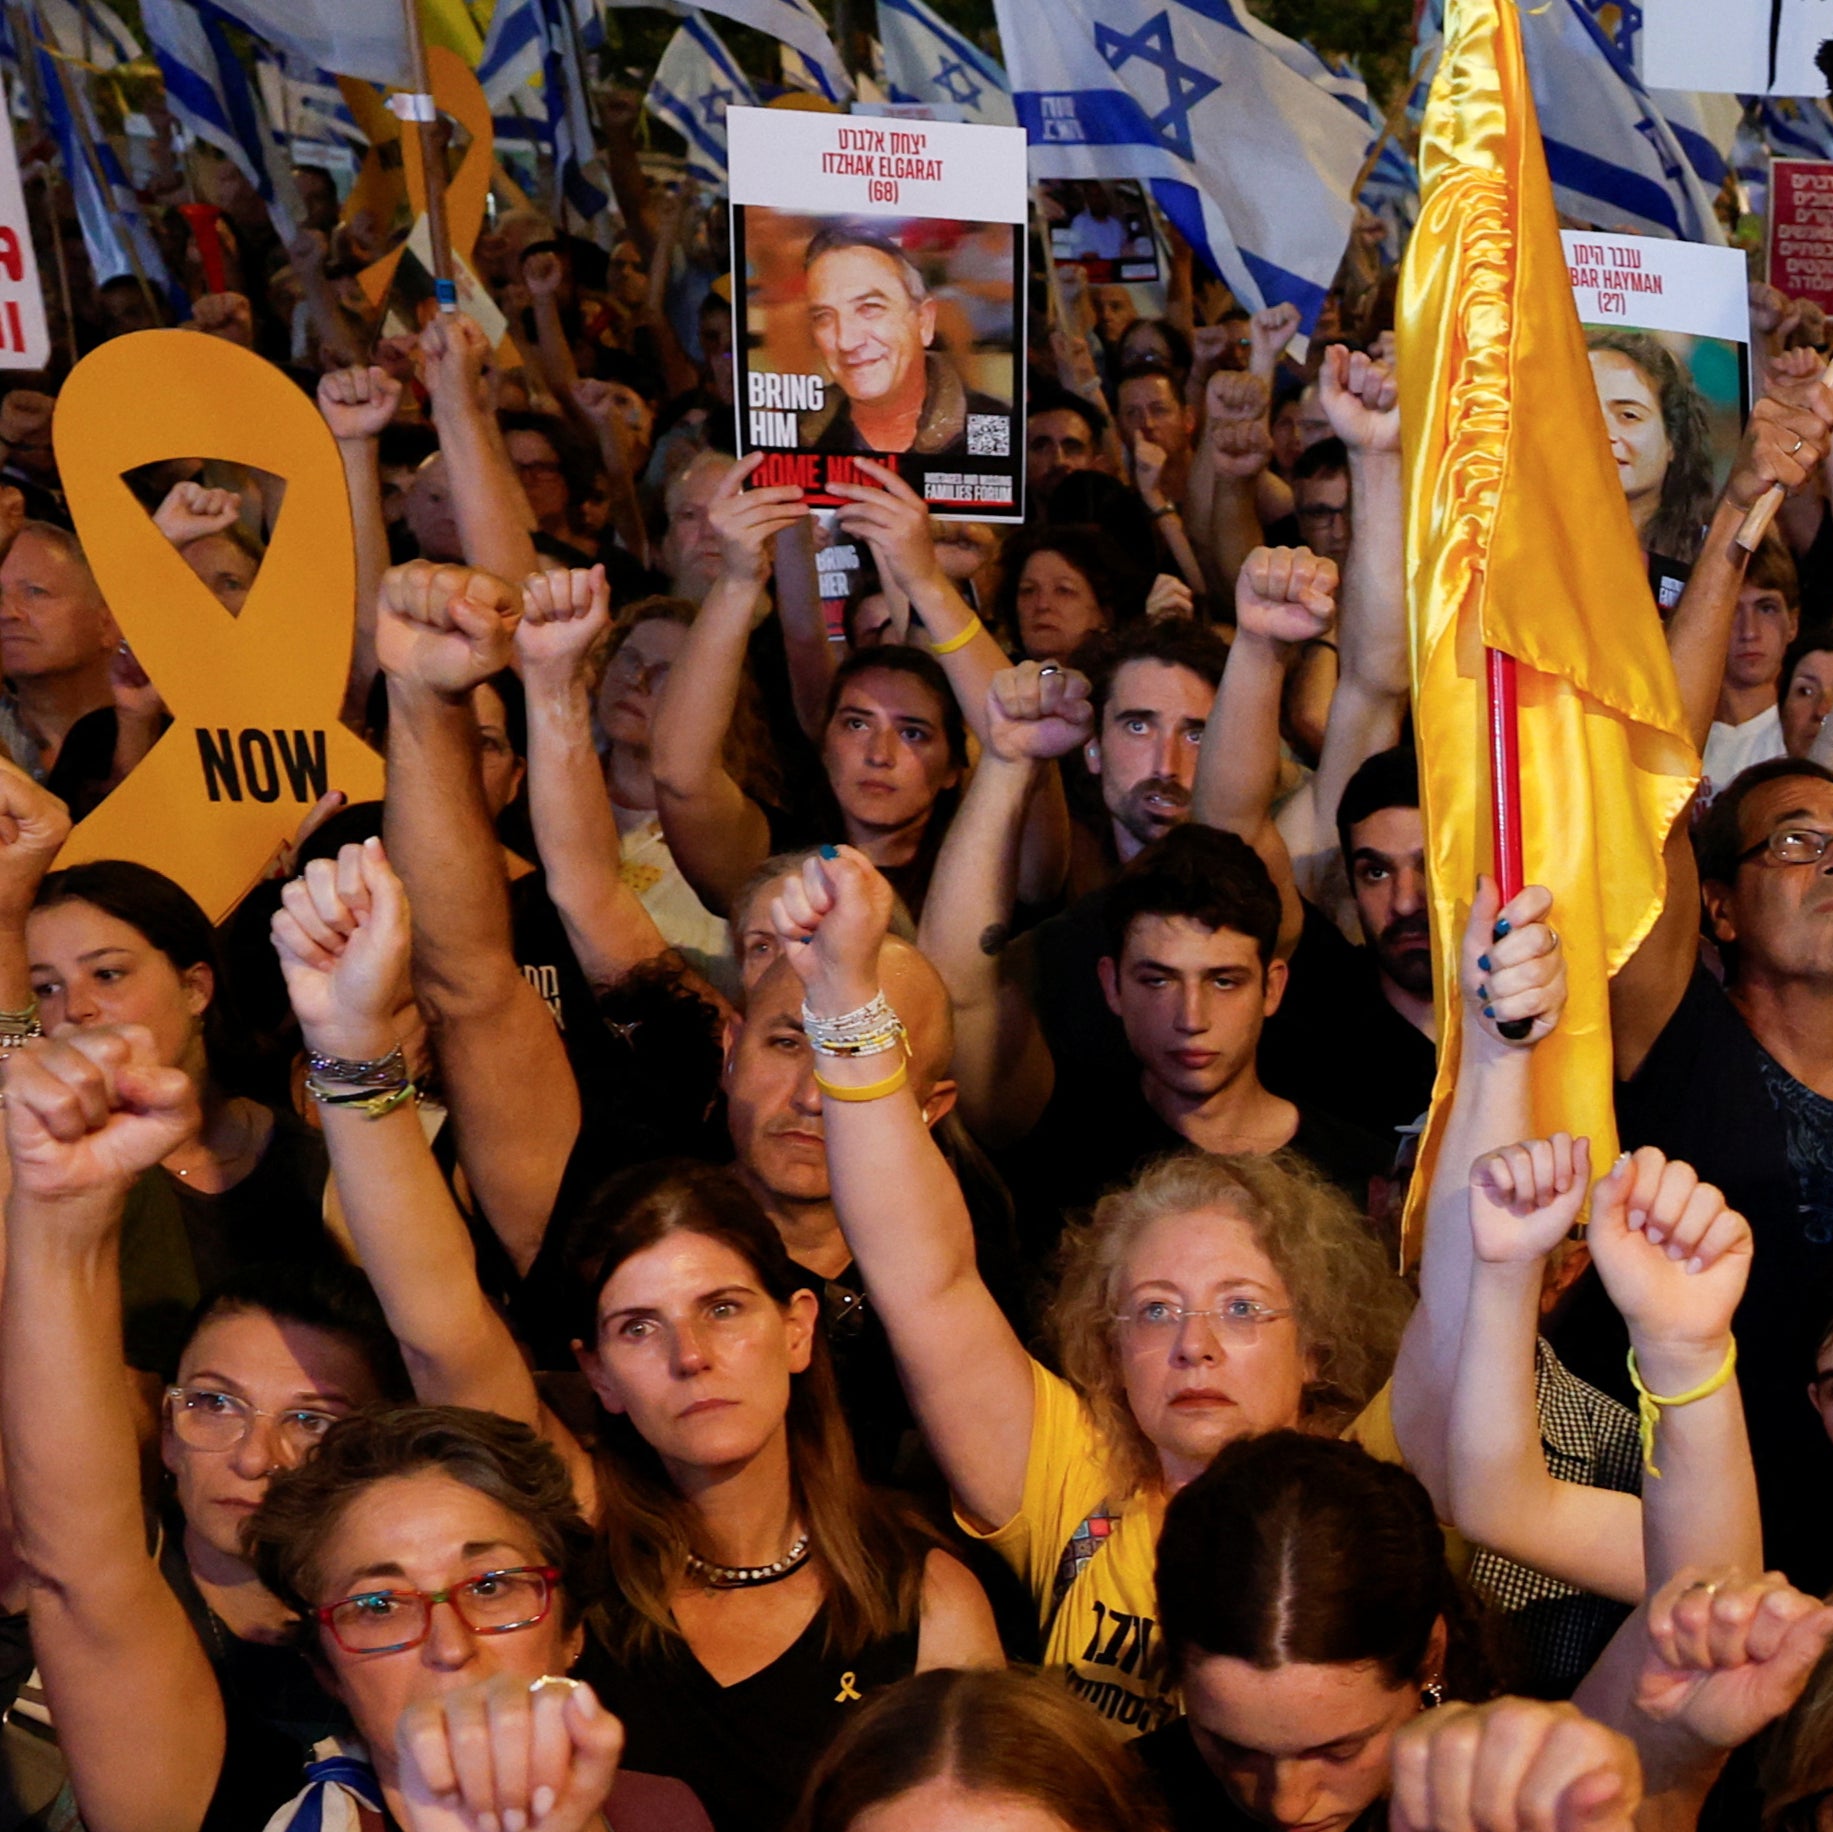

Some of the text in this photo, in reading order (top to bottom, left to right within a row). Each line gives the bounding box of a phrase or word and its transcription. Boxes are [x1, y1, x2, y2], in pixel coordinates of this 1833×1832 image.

[838, 128, 926, 155] יצחק אלגרט
[822, 152, 943, 181] ITZHAK ELGARAT
[868, 179, 899, 204] (68)
[1573, 244, 1641, 269] ענבר הימן
[1603, 270, 1663, 295] HAYMAN
[1598, 291, 1626, 315] (27)
[749, 371, 824, 411] BRING
[750, 409, 798, 448] HIM
[818, 571, 850, 598] HER
